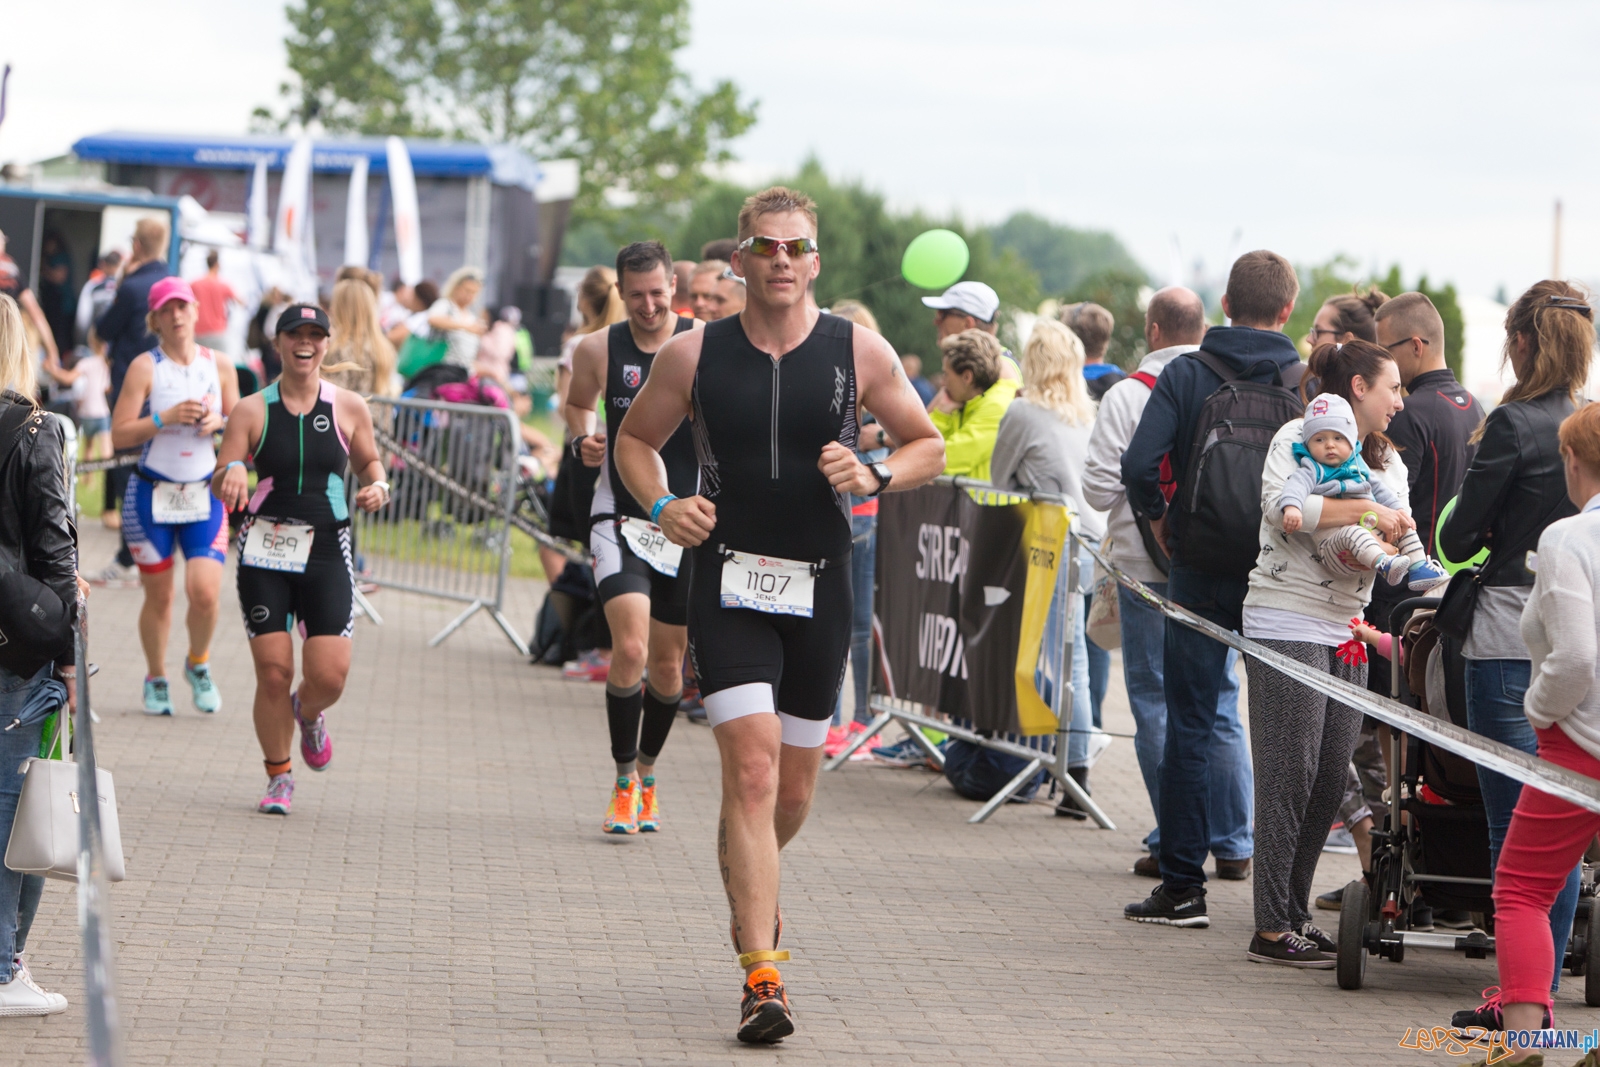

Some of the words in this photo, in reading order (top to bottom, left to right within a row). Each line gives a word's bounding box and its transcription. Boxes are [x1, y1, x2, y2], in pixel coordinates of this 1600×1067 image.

[262, 532, 298, 553] 629
[637, 532, 666, 552] 819
[746, 570, 792, 595] 1107
[754, 593, 777, 602] JENS
